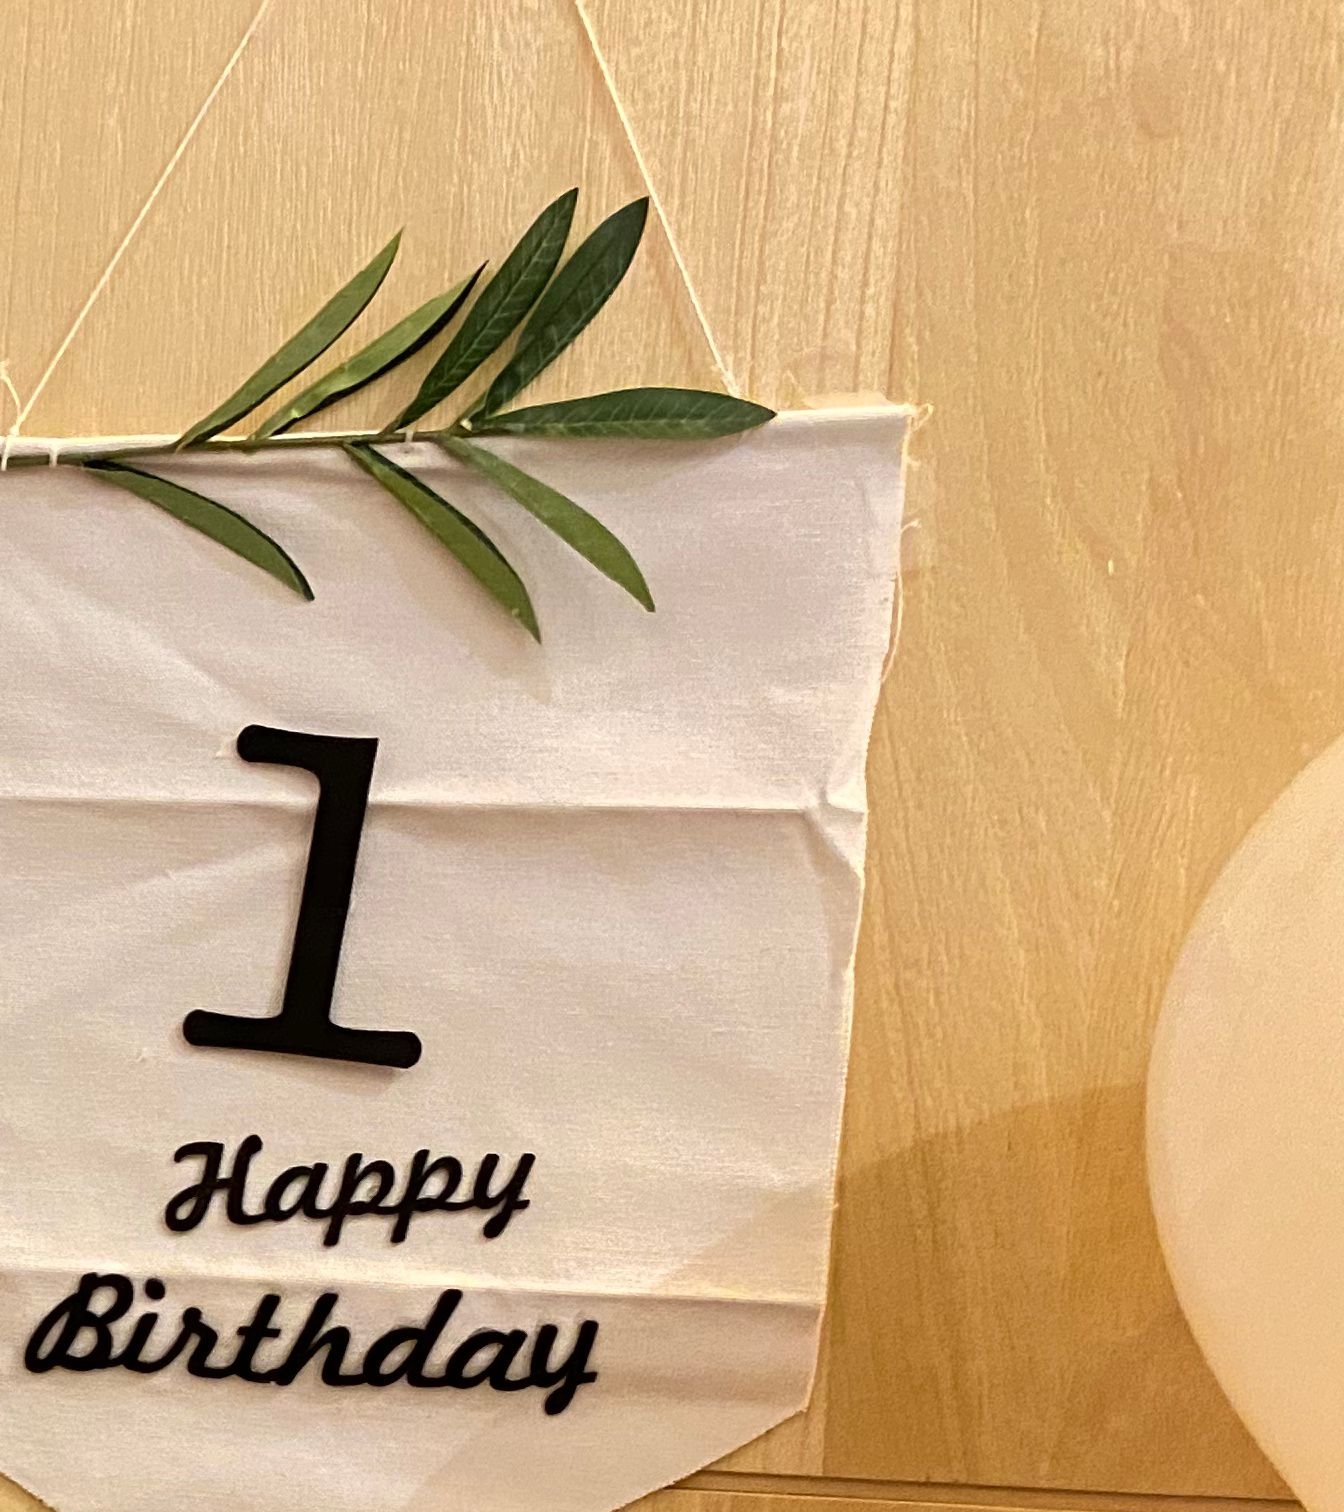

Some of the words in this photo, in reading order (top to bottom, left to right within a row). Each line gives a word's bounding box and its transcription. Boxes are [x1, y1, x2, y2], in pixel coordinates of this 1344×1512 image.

[182, 724, 422, 1070] 1
[164, 1134, 536, 1248] Happy
[23, 1271, 600, 1416] Birthday
